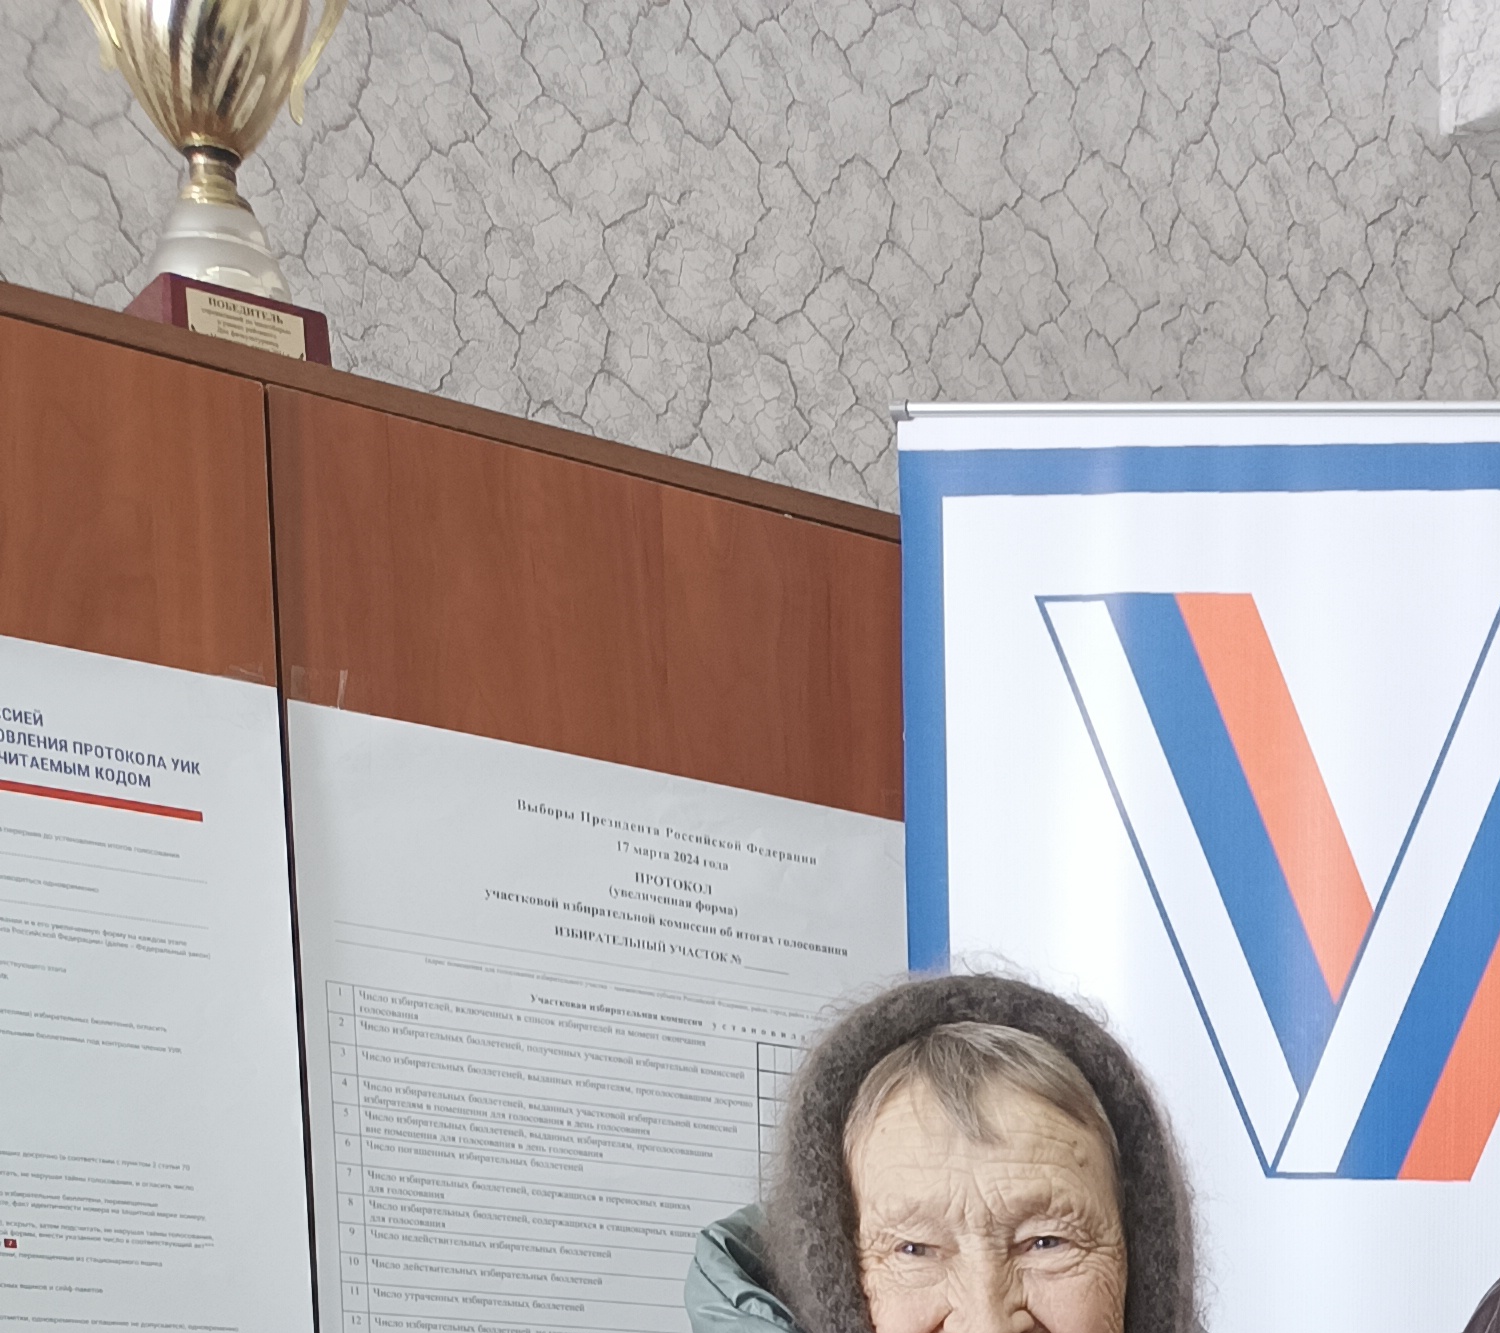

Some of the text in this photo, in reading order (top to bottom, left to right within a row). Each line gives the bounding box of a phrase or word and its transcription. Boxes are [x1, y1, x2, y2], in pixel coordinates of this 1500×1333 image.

[208, 297, 283, 324] ПОБЕДИТЕЛЬ
[0, 707, 43, 727] СИЕЙ
[73, 741, 167, 770] ПРОТОКОЛА
[172, 758, 201, 776] УИК
[95, 767, 151, 787] КОДОМ
[516, 798, 818, 865] Выборы Президента Российской Федерации
[616, 841, 728, 872] 17 марта 2024 года
[635, 872, 712, 895] ПРОТОКОЛ
[608, 885, 738, 919] (увеличенная форма)
[484, 890, 848, 957] участковой избирательной комиссии об итогах голосования
[554, 925, 666, 954] ИЗБИРАТЕЛЬНЫЙ
[670, 944, 728, 964] УЧАСТОК
[358, 988, 388, 1002] Число
[390, 994, 454, 1014] избирателей,
[558, 1018, 612, 1034] избирателей
[628, 1028, 660, 1040] момент
[359, 1005, 419, 1020] голосования
[338, 1018, 344, 1027] 2
[360, 1019, 390, 1033] Число
[392, 1025, 464, 1042] избирательных
[466, 1033, 524, 1053] бюллетеней,
[584, 1051, 634, 1065] участковой
[636, 1056, 698, 1073] избирательной
[340, 1048, 346, 1057] 3
[362, 1050, 392, 1063] Число
[394, 1055, 464, 1072] избирательных
[342, 1078, 347, 1086] 4
[363, 1080, 392, 1093] Число
[395, 1085, 466, 1102] избирательных
[576, 1108, 626, 1121] участковой
[628, 1112, 690, 1128] избирательной
[352, 1316, 361, 1325] 12
[374, 1317, 403, 1328] Число
[405, 1320, 475, 1333] избирательных
